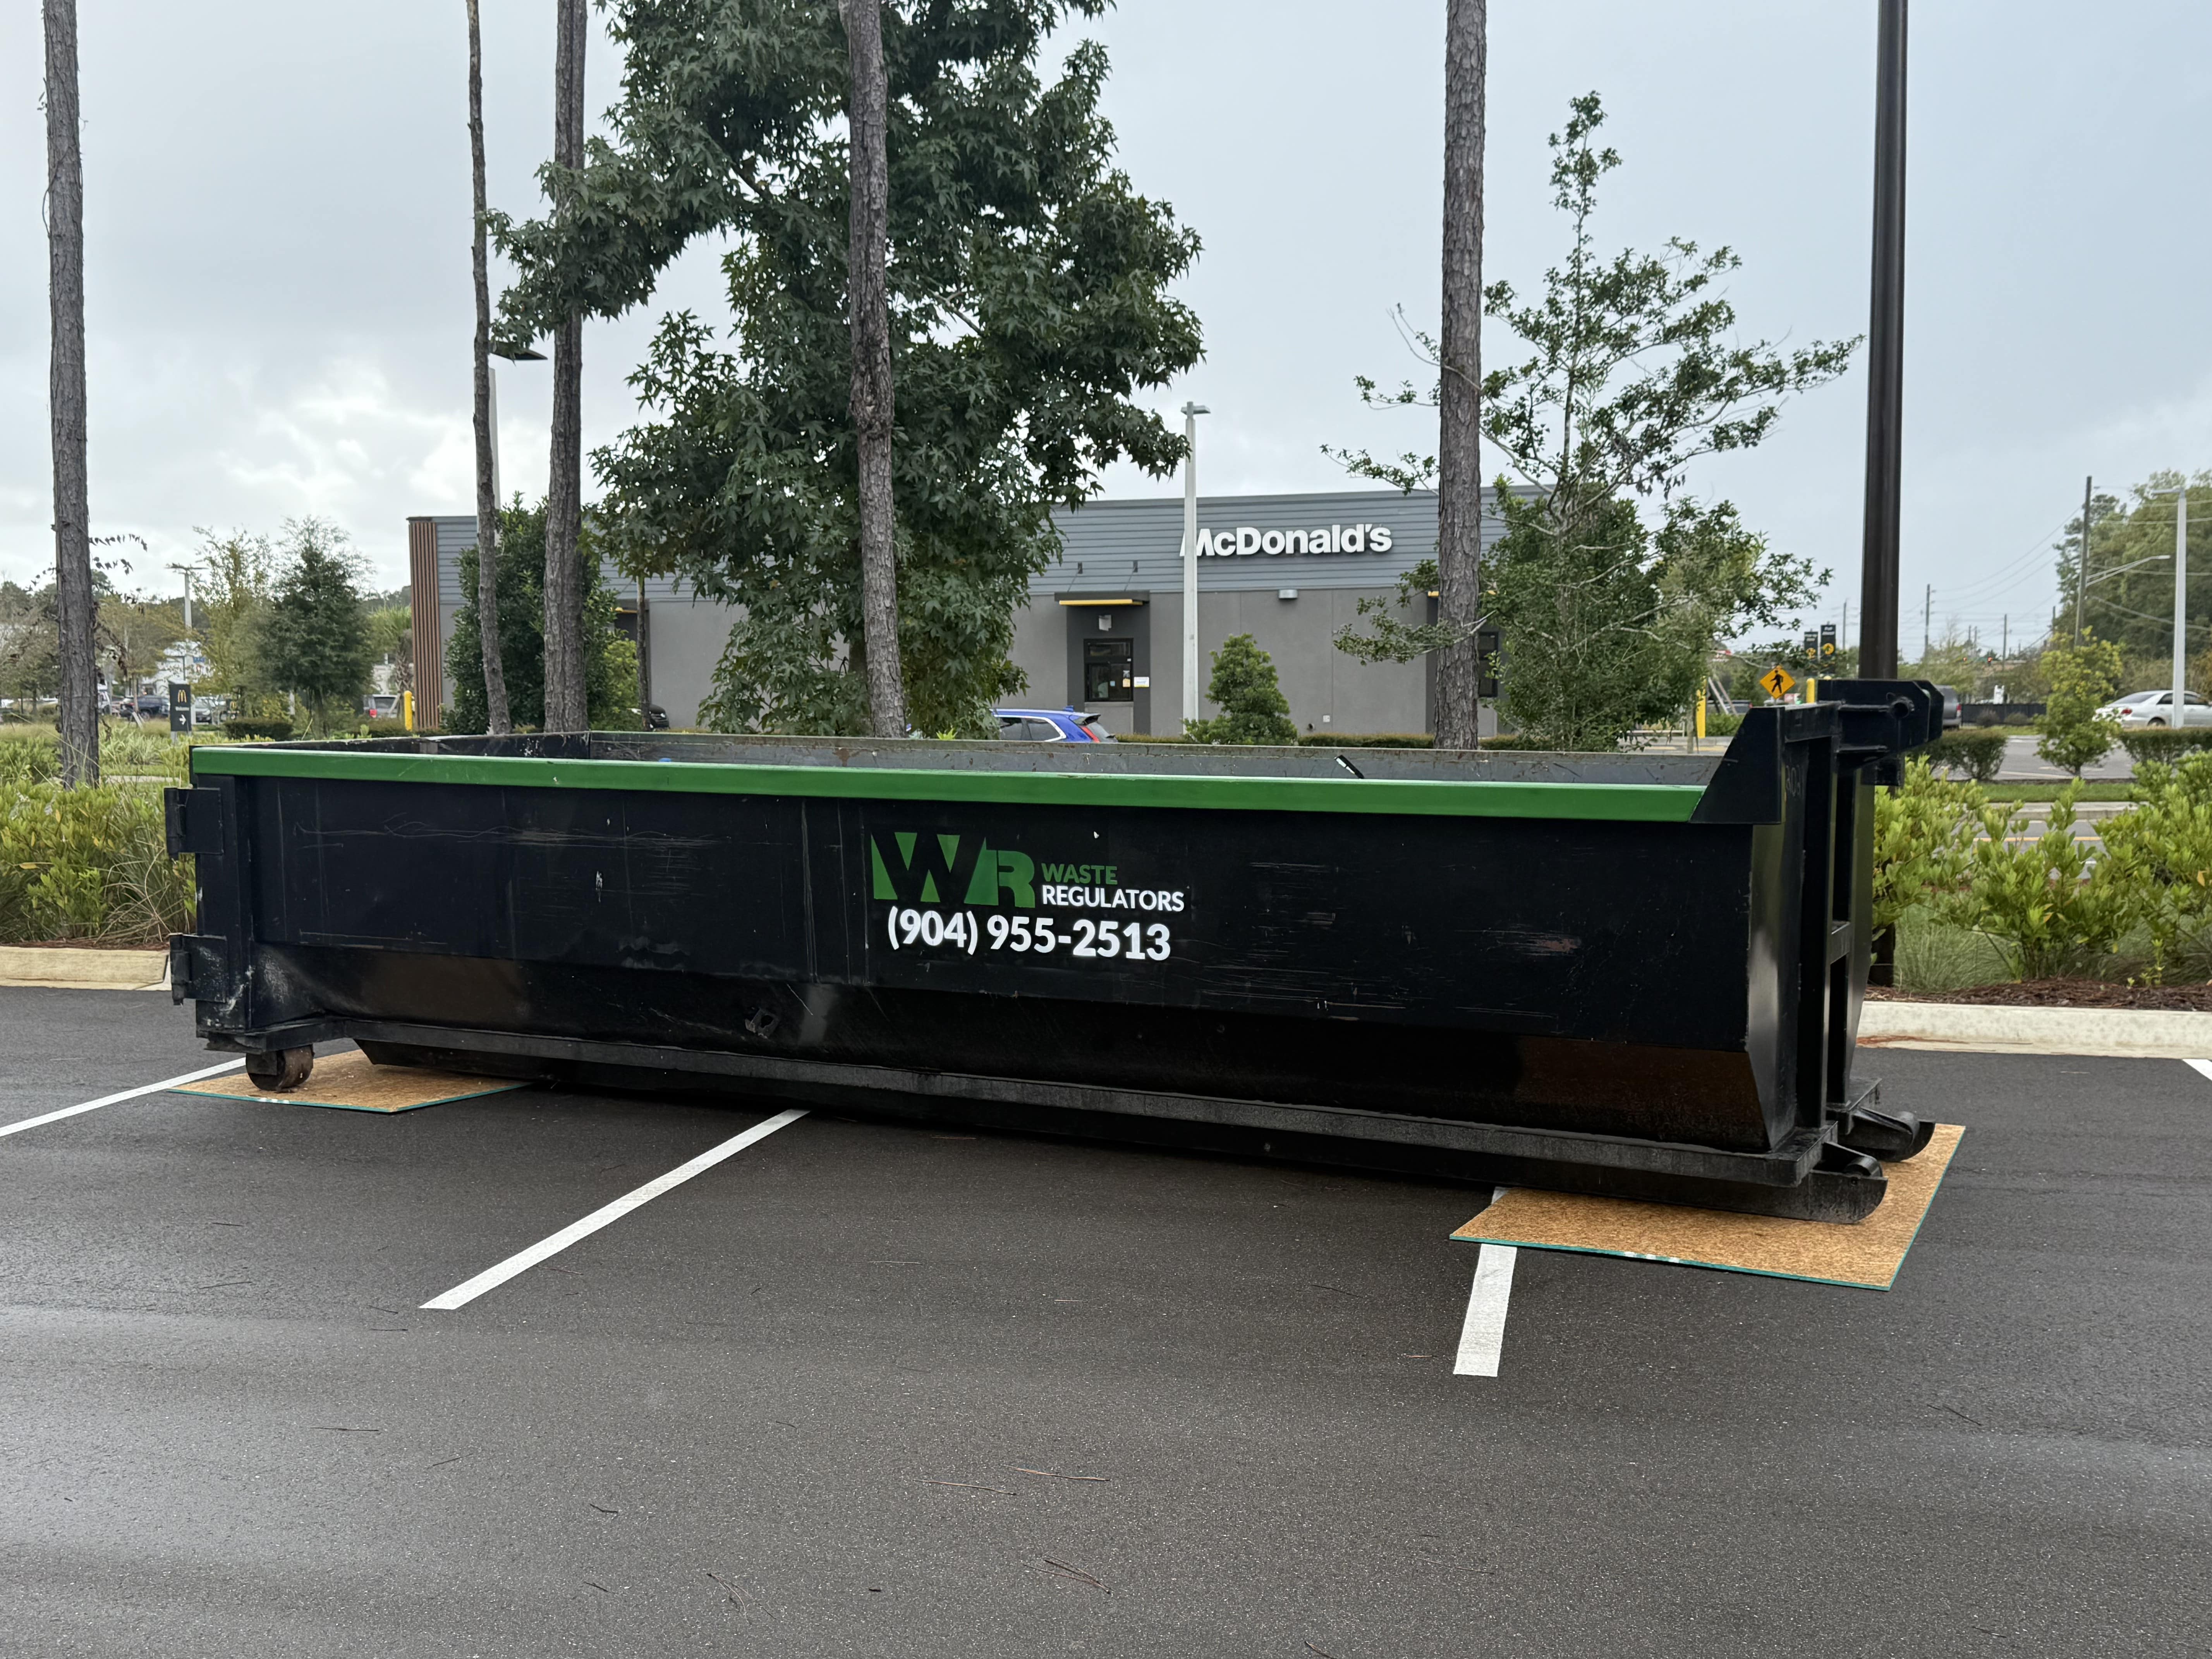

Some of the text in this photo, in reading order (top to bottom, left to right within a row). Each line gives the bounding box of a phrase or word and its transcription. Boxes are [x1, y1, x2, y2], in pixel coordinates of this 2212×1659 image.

[1180, 524, 1392, 556] McDonald's
[871, 832, 1036, 908] WR
[1041, 863, 1117, 884] WASTE
[1042, 885, 1185, 912] REGULATORS
[888, 906, 1171, 961] (904) 955-2513
